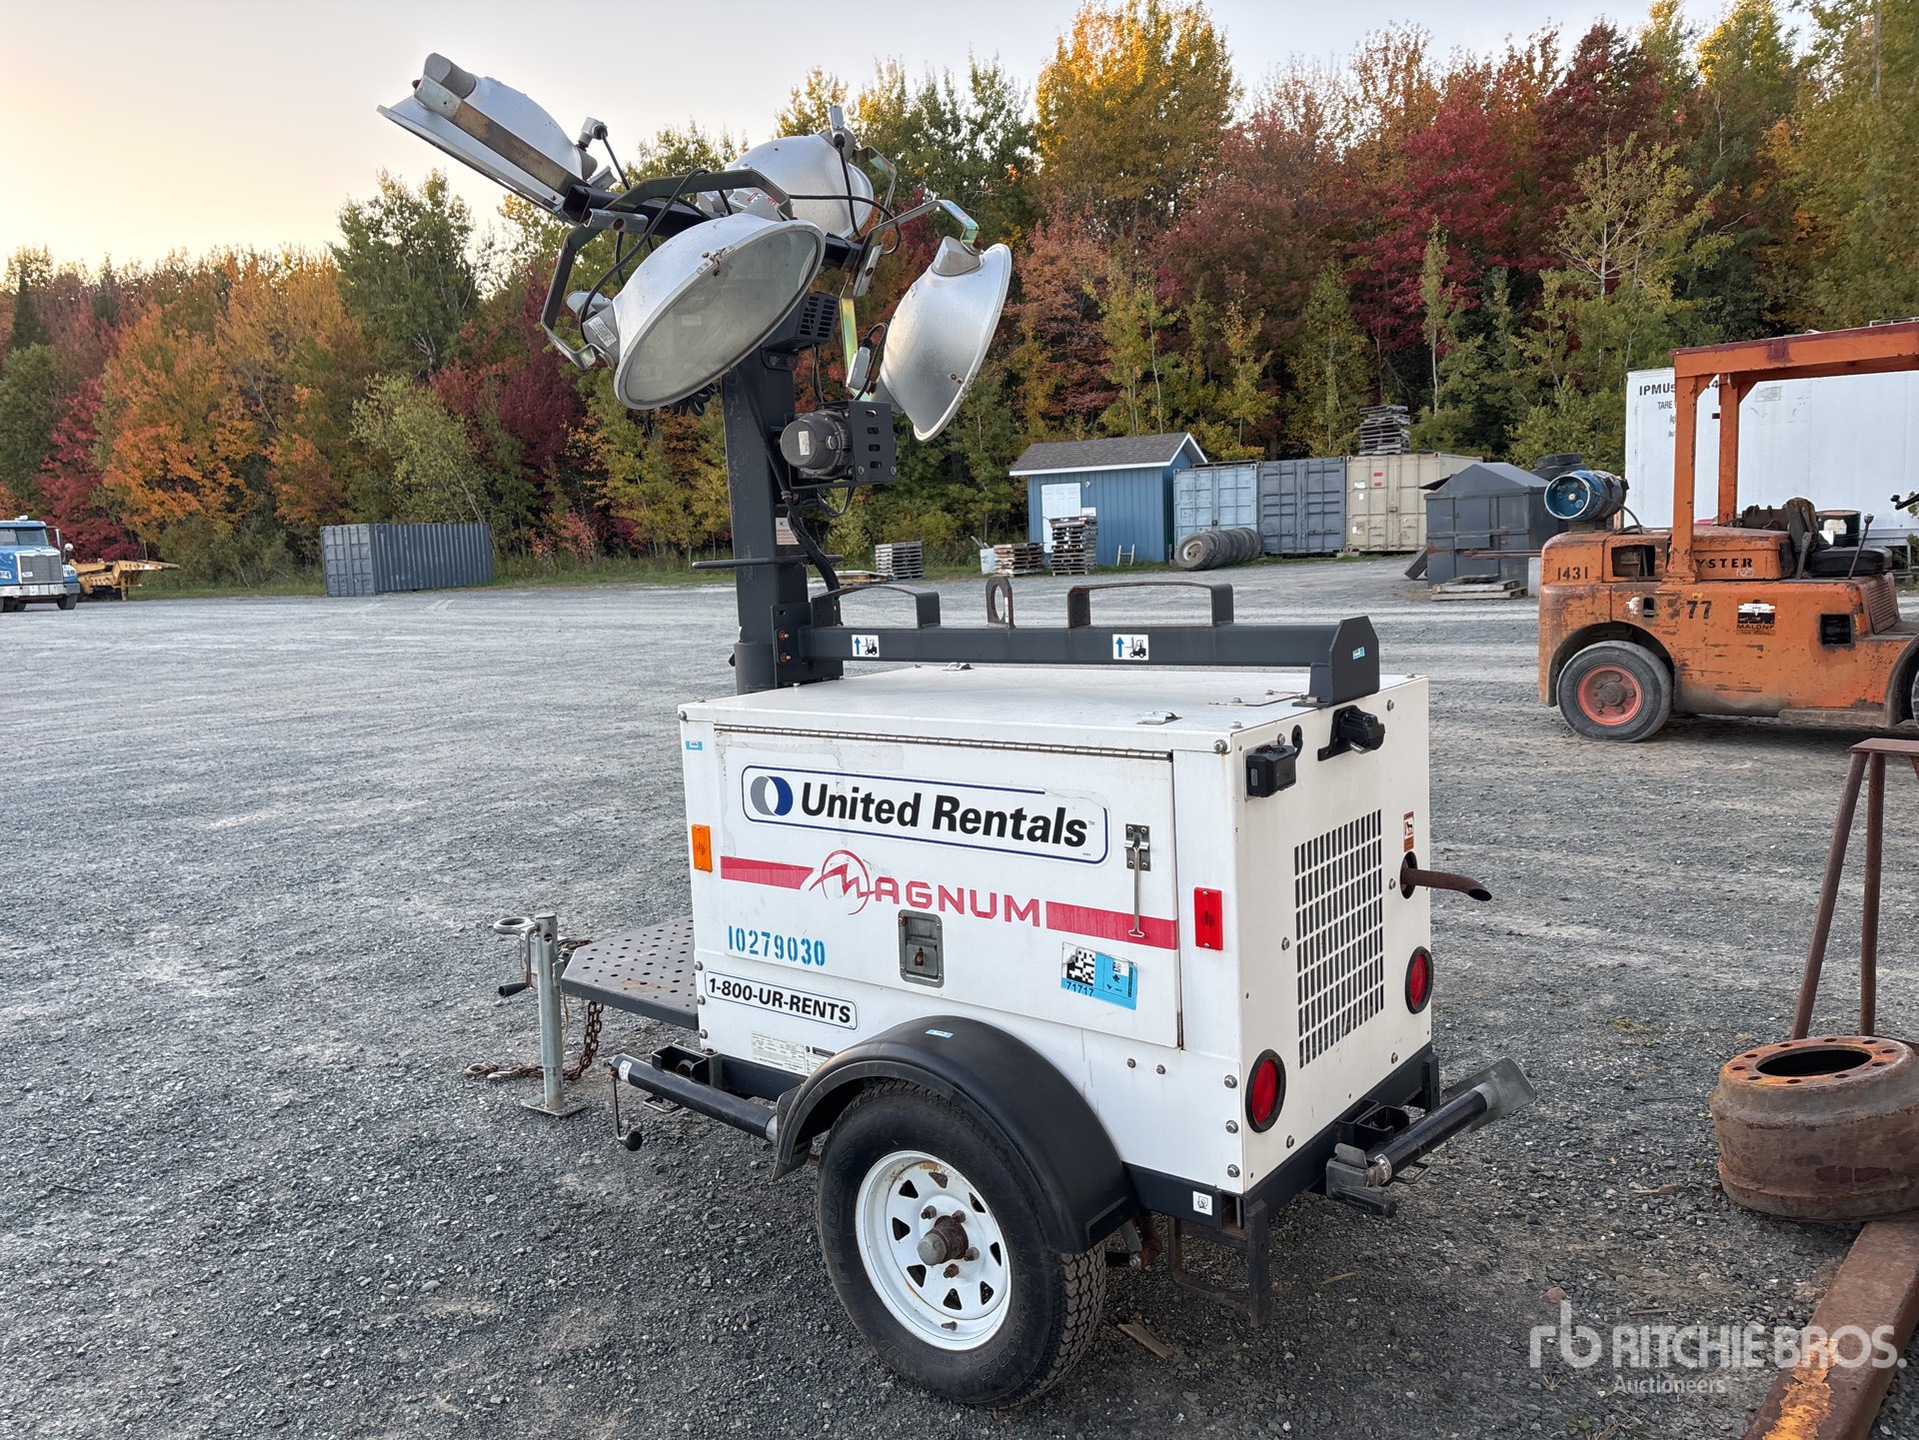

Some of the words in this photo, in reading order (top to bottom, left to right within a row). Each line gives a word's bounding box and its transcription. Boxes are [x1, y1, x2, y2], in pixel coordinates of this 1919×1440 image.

[1657, 400, 1673, 410] TARE
[1694, 557, 1753, 569] YSTER
[1557, 566, 1588, 581] 1431
[1686, 600, 1712, 619] 77
[801, 782, 922, 828] United
[932, 794, 1088, 847] Rentals
[809, 862, 1041, 928] MAGNUM
[728, 925, 826, 967] 10279030
[1066, 980, 1095, 998] 71717
[709, 977, 852, 1024] 1-800-UR-RENTS
